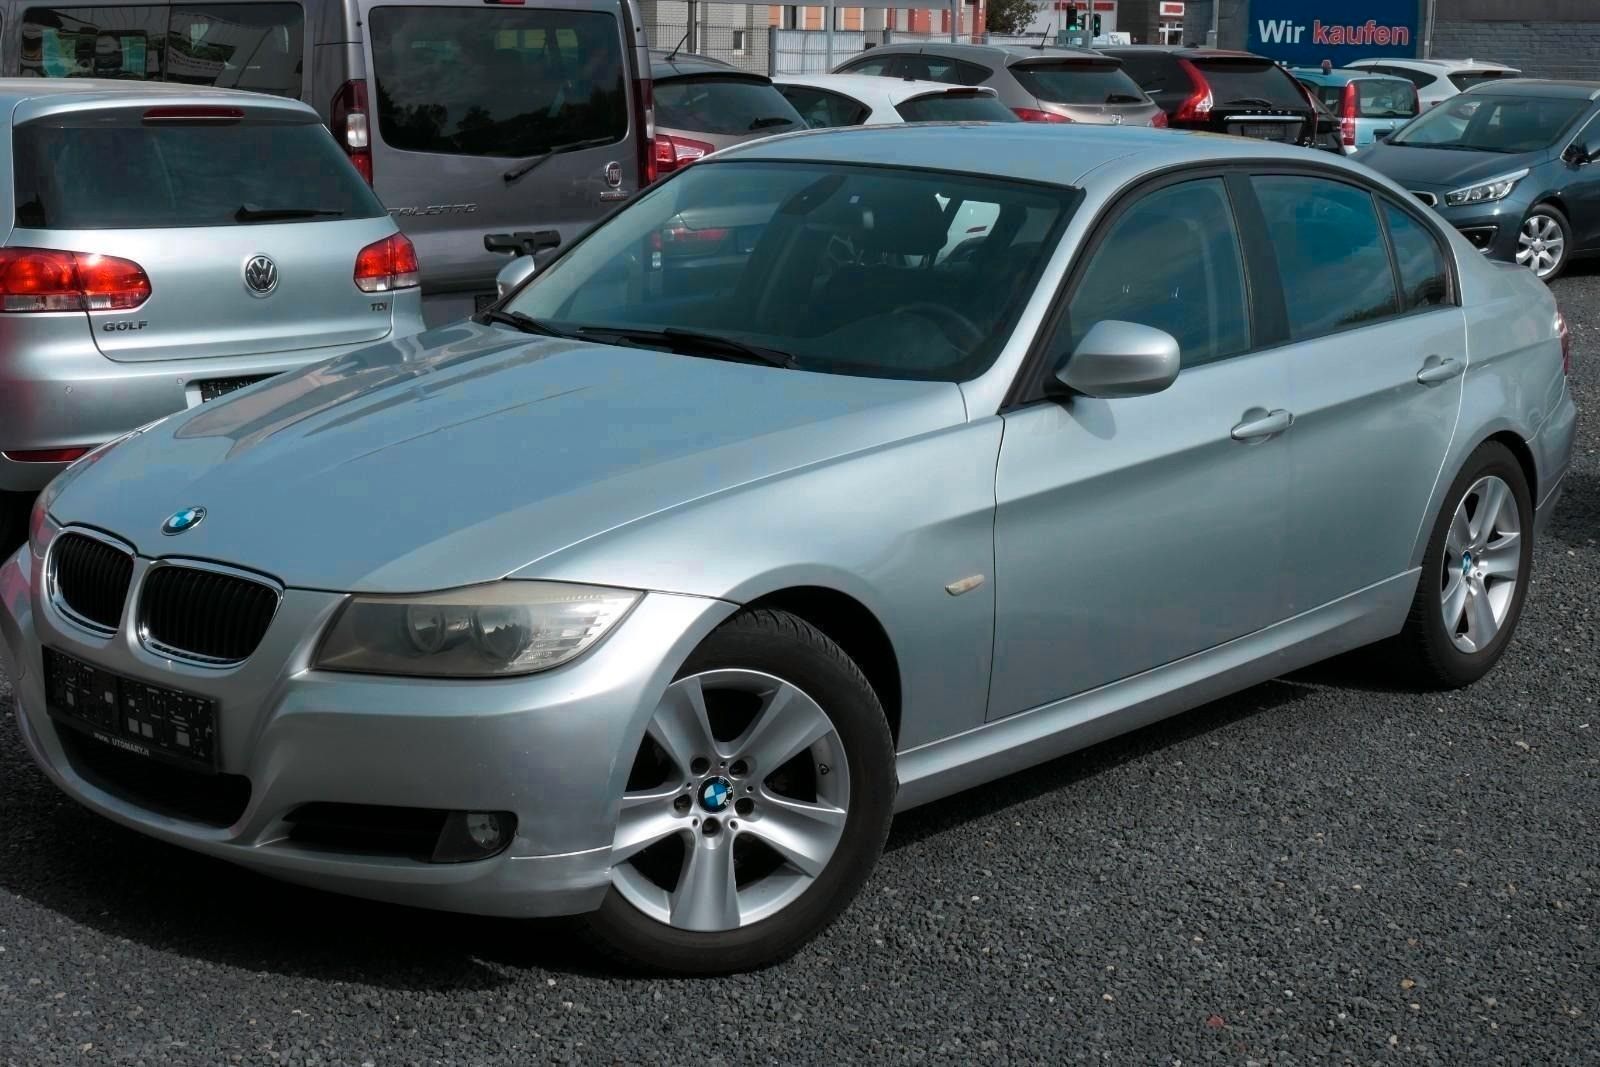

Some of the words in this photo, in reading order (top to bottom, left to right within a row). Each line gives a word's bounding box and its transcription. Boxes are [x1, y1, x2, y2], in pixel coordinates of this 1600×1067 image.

[1258, 20, 1305, 43] Wir
[1312, 20, 1409, 45] kaufen
[102, 319, 149, 332] GOLF
